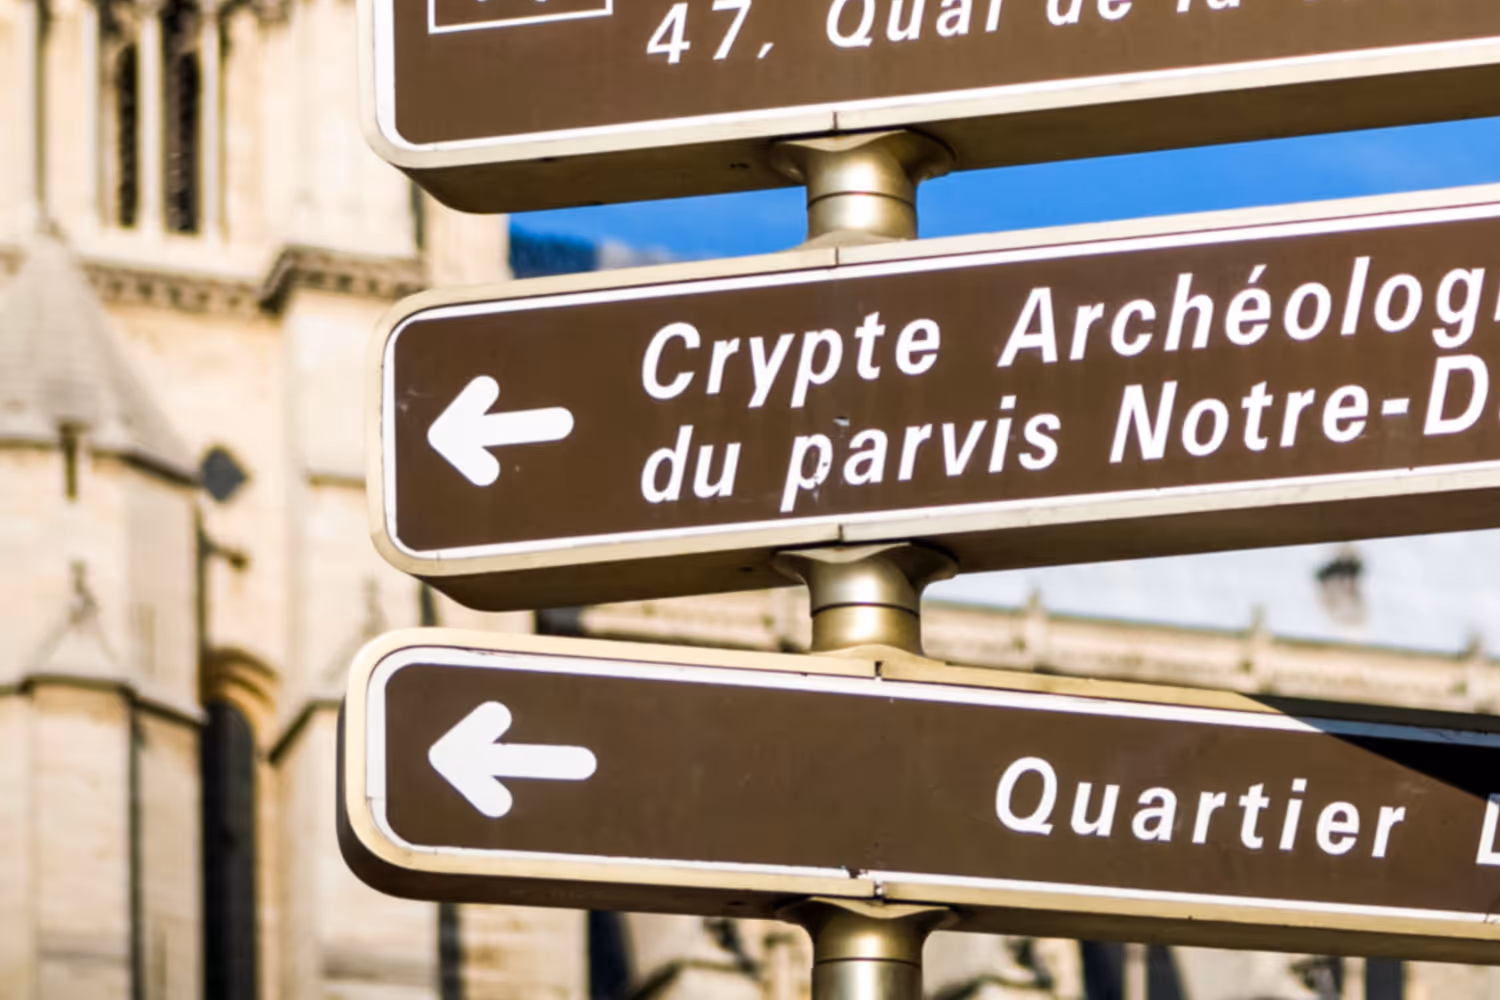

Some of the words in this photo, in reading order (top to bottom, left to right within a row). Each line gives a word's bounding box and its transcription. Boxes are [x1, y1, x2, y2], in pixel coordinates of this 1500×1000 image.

[642, 312, 940, 408] Crypte
[641, 425, 741, 503] du
[780, 395, 1061, 513] parvis
[996, 757, 1406, 857] Quartier
